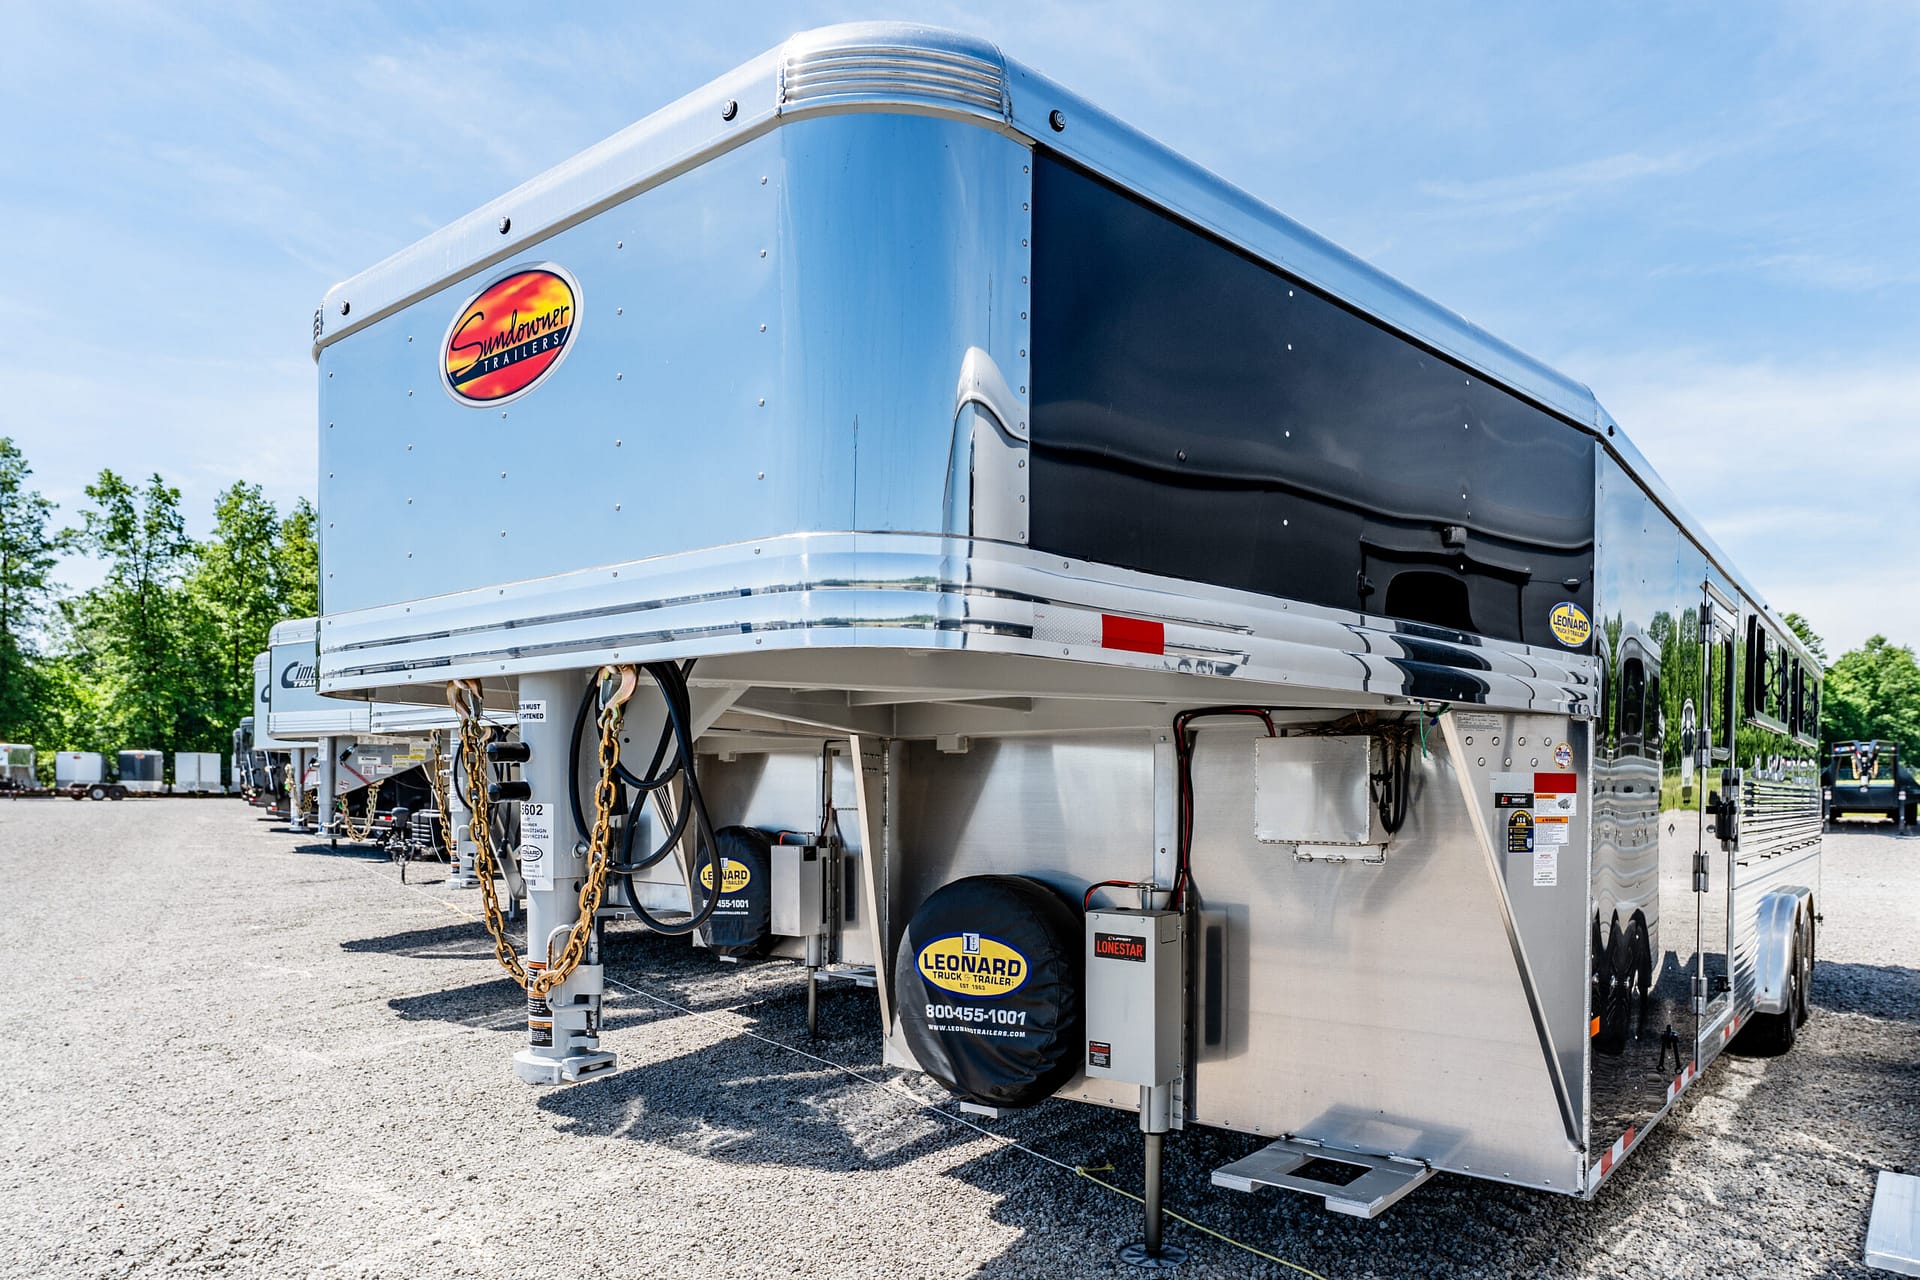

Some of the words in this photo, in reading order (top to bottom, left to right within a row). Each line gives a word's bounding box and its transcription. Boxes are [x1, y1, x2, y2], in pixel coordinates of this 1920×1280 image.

[451, 305, 570, 375] Sundowner
[483, 333, 560, 372] TRAILERS
[1553, 614, 1588, 632] LEONARD
[703, 870, 748, 880] LENARD
[1096, 939, 1143, 958] LONESTAR
[923, 953, 1022, 977] LEONARD
[933, 971, 962, 981] TRUCK
[973, 974, 1011, 987] TRAILER
[925, 1004, 1027, 1026] 800-455-1001
